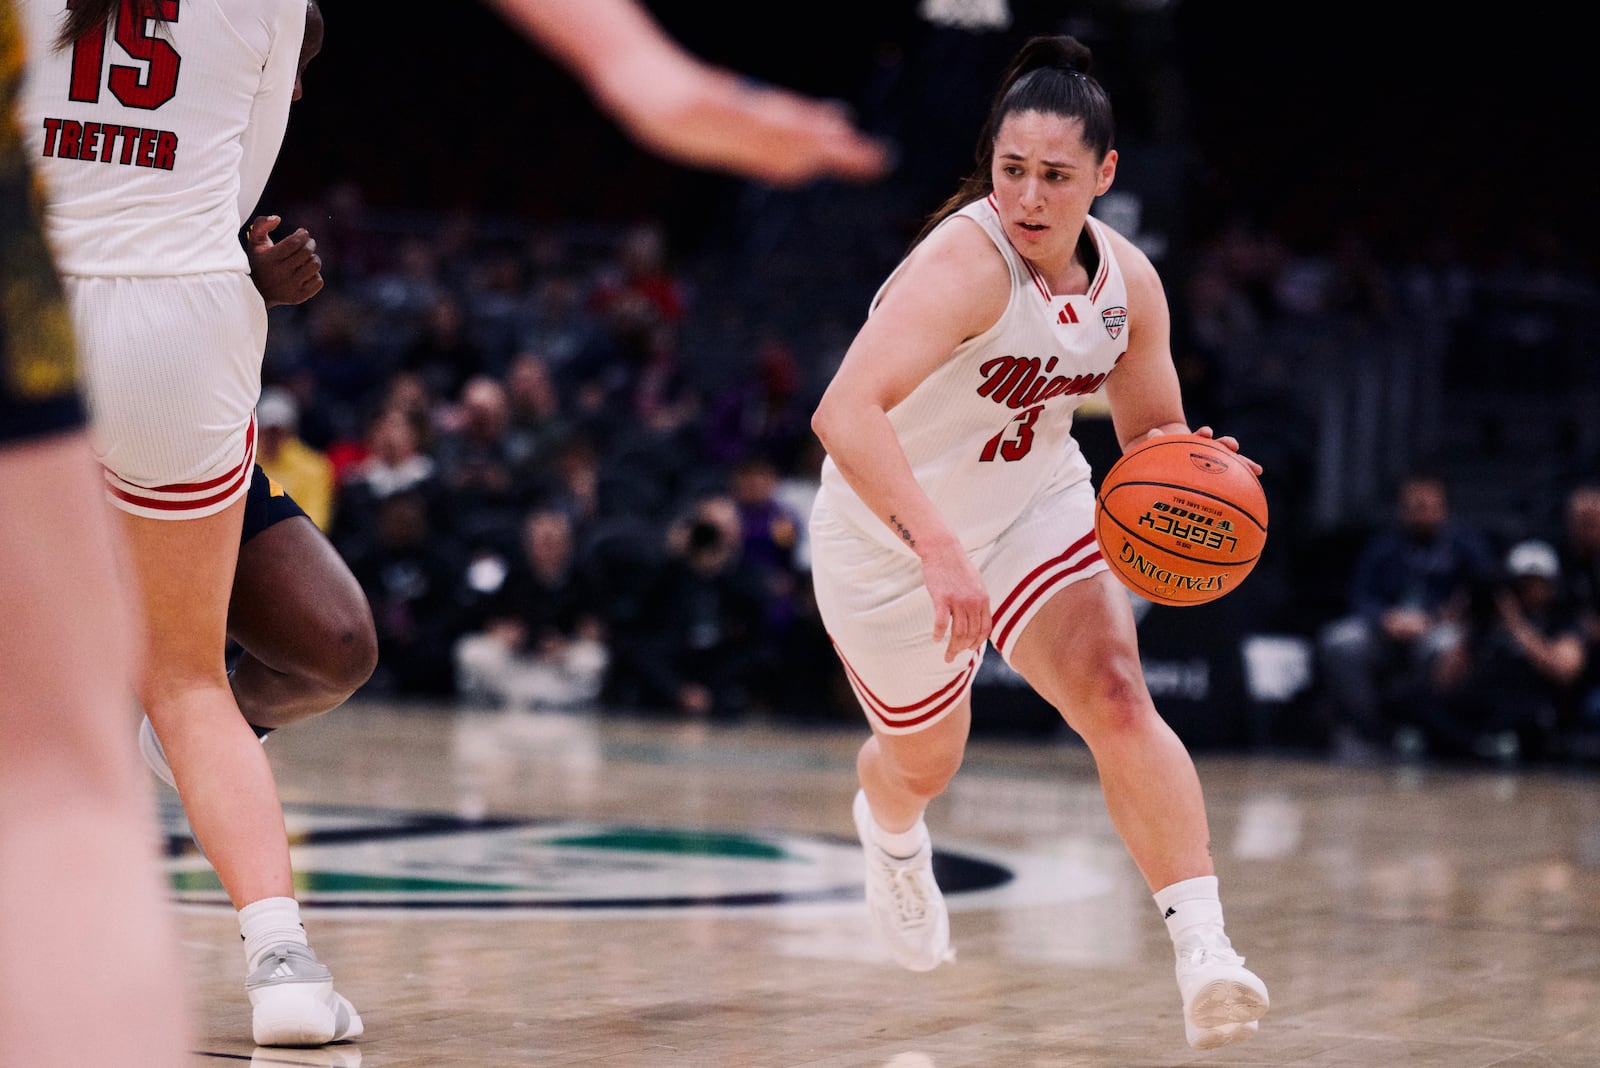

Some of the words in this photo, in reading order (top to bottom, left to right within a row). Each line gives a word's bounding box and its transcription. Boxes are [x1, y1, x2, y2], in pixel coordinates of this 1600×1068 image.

[66, 0, 181, 110] 15
[43, 117, 178, 170] TRETTER
[1104, 315, 1127, 327] MAC
[977, 352, 1126, 409] Miam
[979, 405, 1045, 462] 13
[1173, 496, 1186, 505] BALL
[1186, 500, 1201, 510] GAME
[1201, 505, 1223, 517] OFFICIAL
[1138, 511, 1238, 553] LEGACY
[1119, 541, 1229, 592] SPALDING
